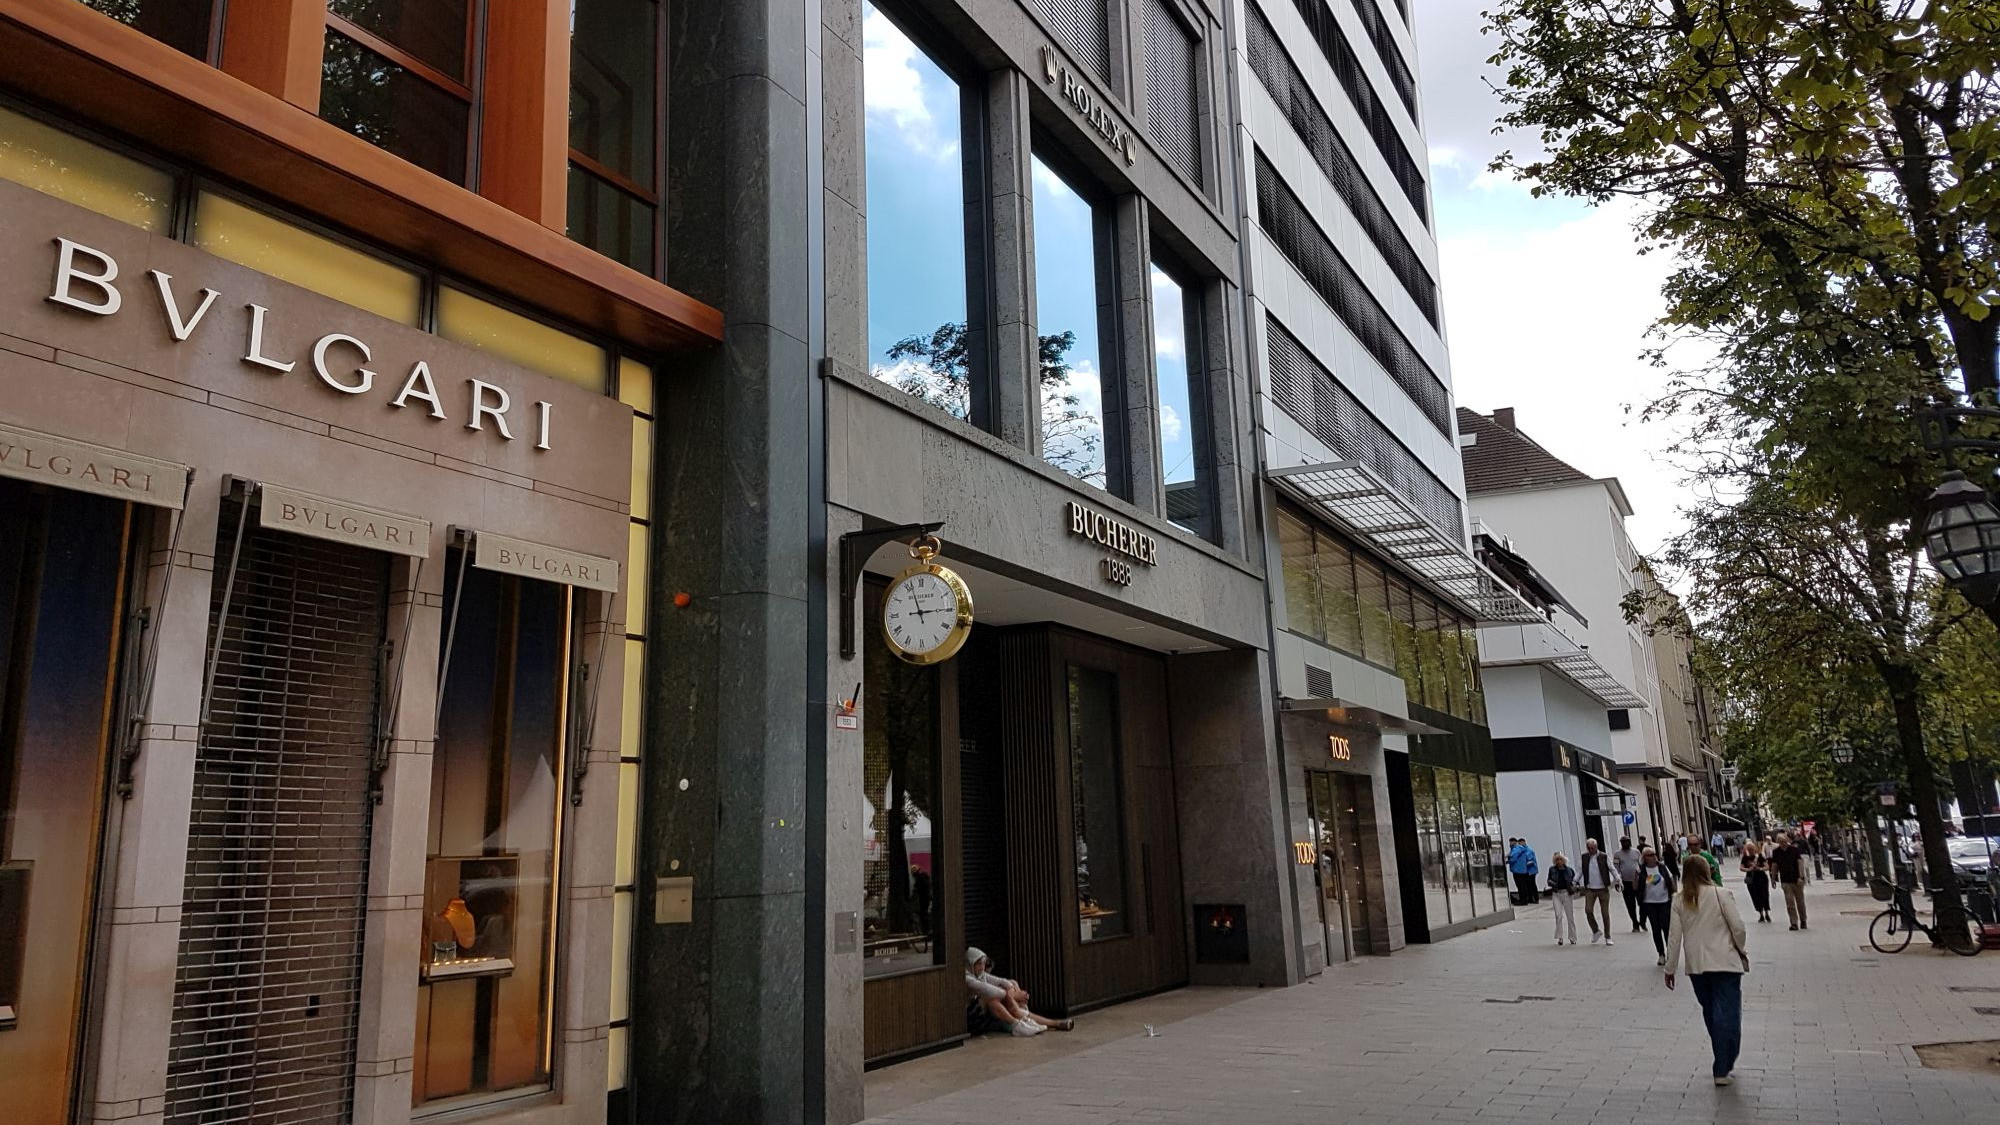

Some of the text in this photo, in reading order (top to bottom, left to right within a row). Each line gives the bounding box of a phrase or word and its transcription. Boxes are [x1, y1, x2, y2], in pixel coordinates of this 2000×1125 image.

[1061, 67, 1123, 153] ROLEX
[48, 236, 553, 452] BVLGARI
[281, 503, 413, 546] BVLGARI
[1070, 501, 1159, 566] BUCHERER
[500, 549, 600, 582] BVLGARI
[1105, 557, 1133, 587] 1888
